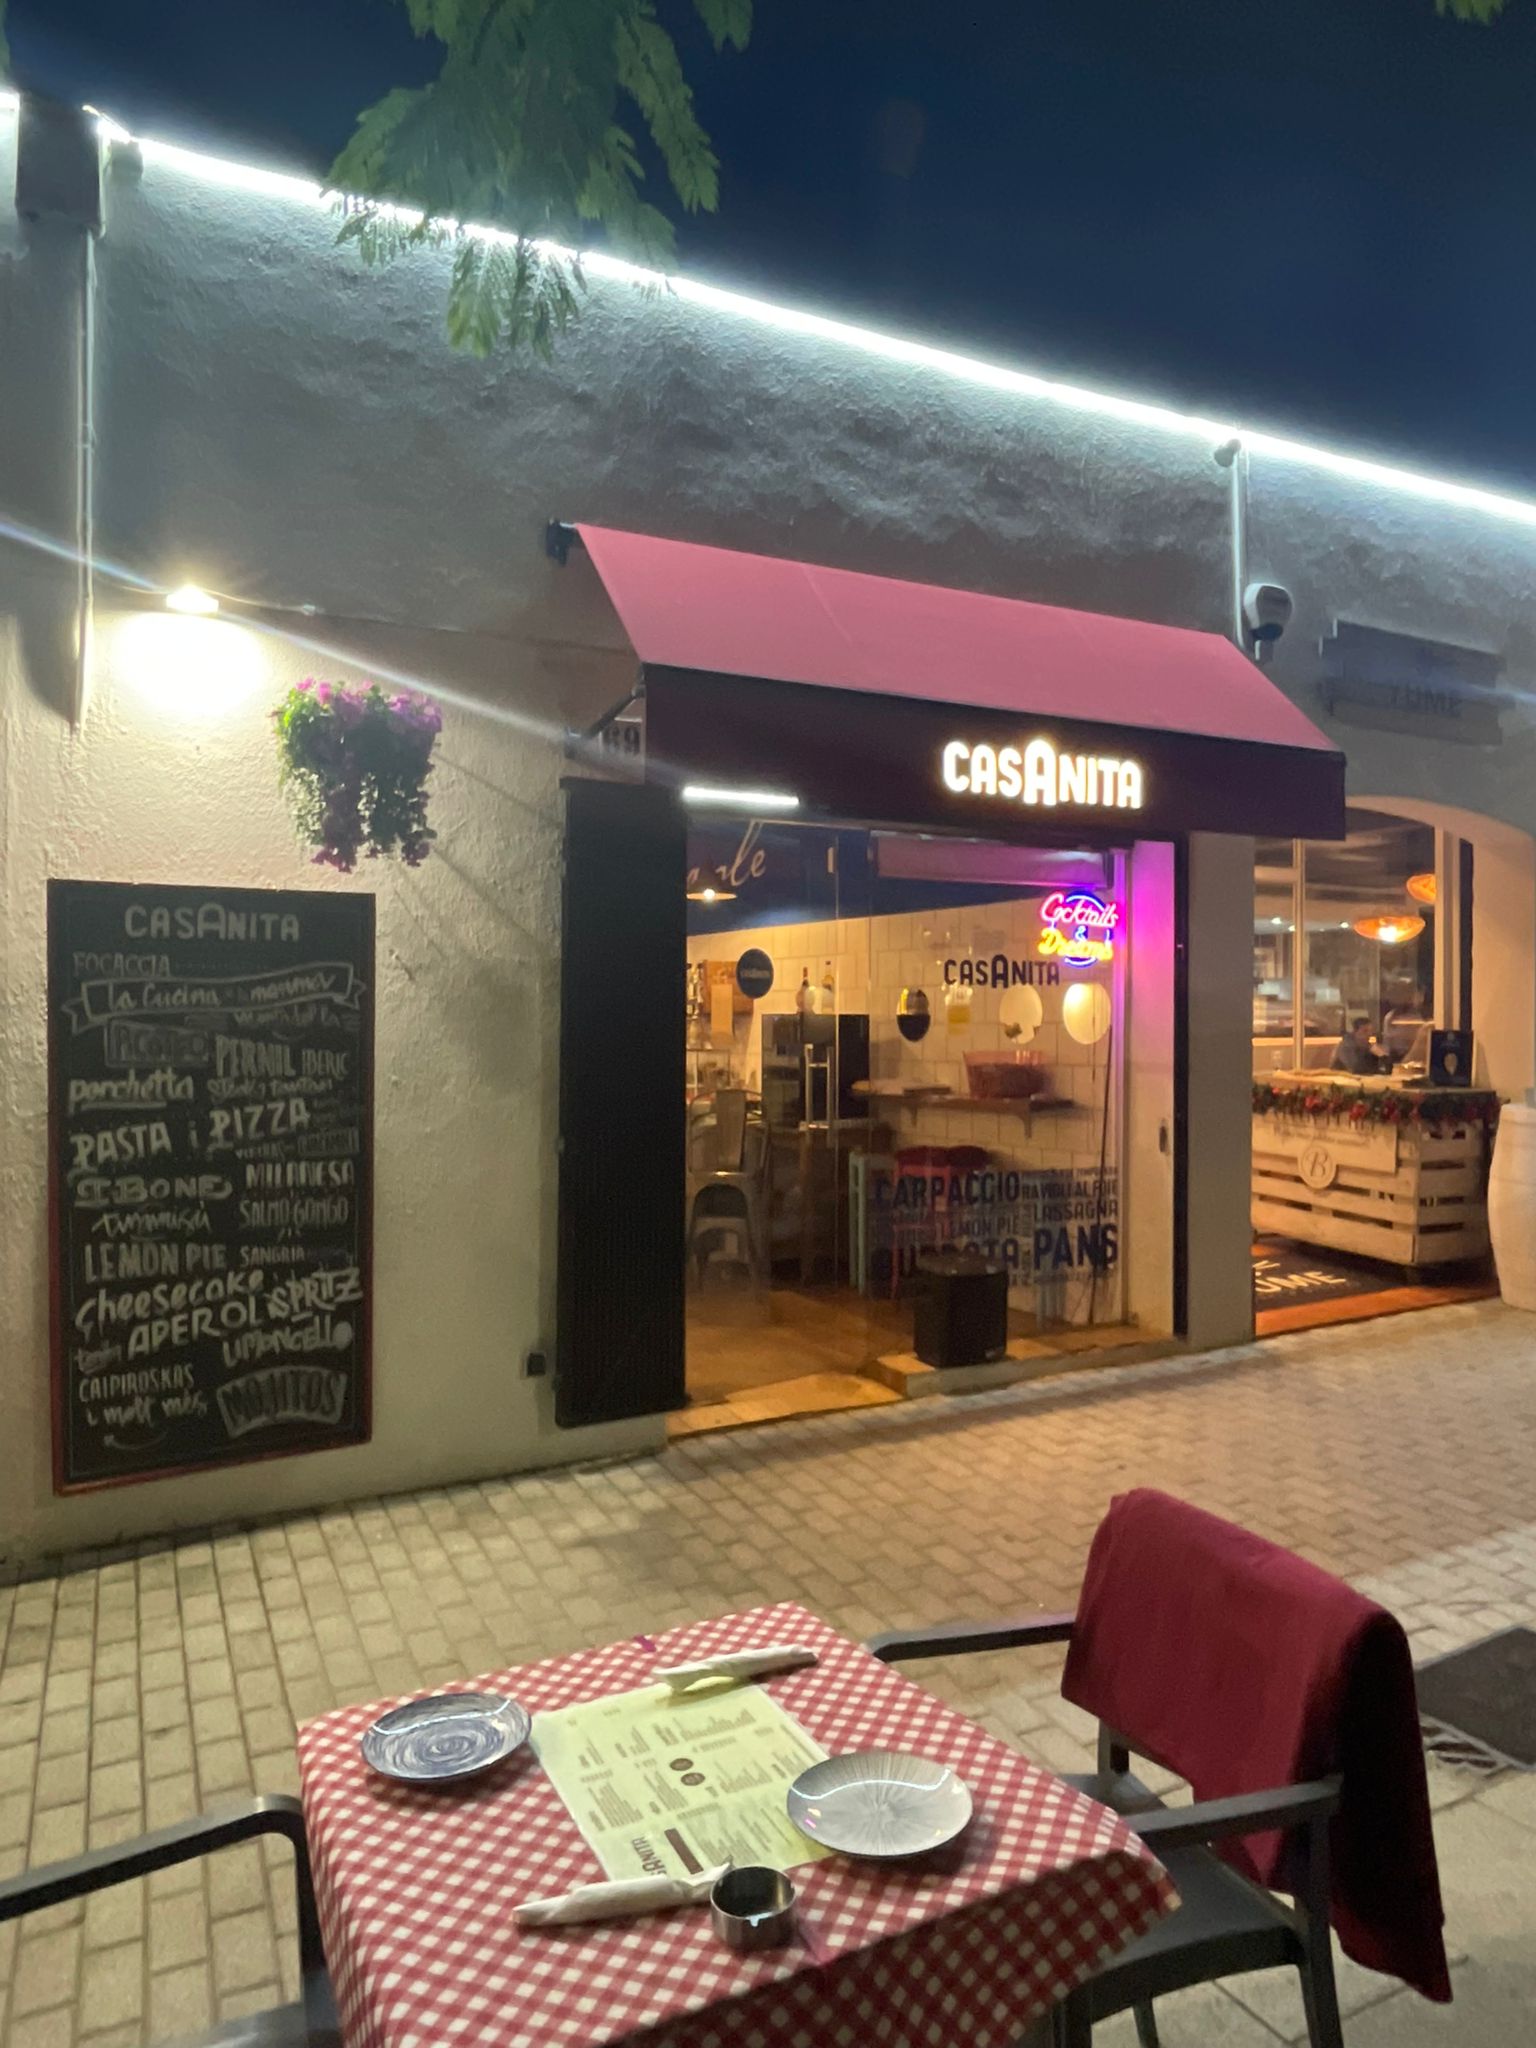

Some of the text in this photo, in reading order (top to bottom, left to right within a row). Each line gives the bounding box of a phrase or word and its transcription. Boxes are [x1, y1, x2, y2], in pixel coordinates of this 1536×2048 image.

[942, 738, 1144, 810] CASANITA
[125, 903, 299, 942] CASANITA
[1040, 891, 1119, 929] Cocktails
[72, 951, 172, 977] FOCACCIA
[944, 954, 1060, 988] CASANITA
[215, 1033, 297, 1080] PERNIL
[68, 1067, 195, 1118] porchetta
[68, 1121, 174, 1180] PASTA
[205, 1097, 313, 1160] PIZZA
[245, 1159, 355, 1191] MILANESA
[875, 1171, 1020, 1209] CARPACCIO
[83, 1242, 228, 1285] LEMON PIE
[240, 1245, 305, 1268] SANGRIA
[1034, 1222, 1119, 1271] PANS
[127, 1295, 265, 1361] APEROL
[266, 1266, 364, 1320] SPRITZ
